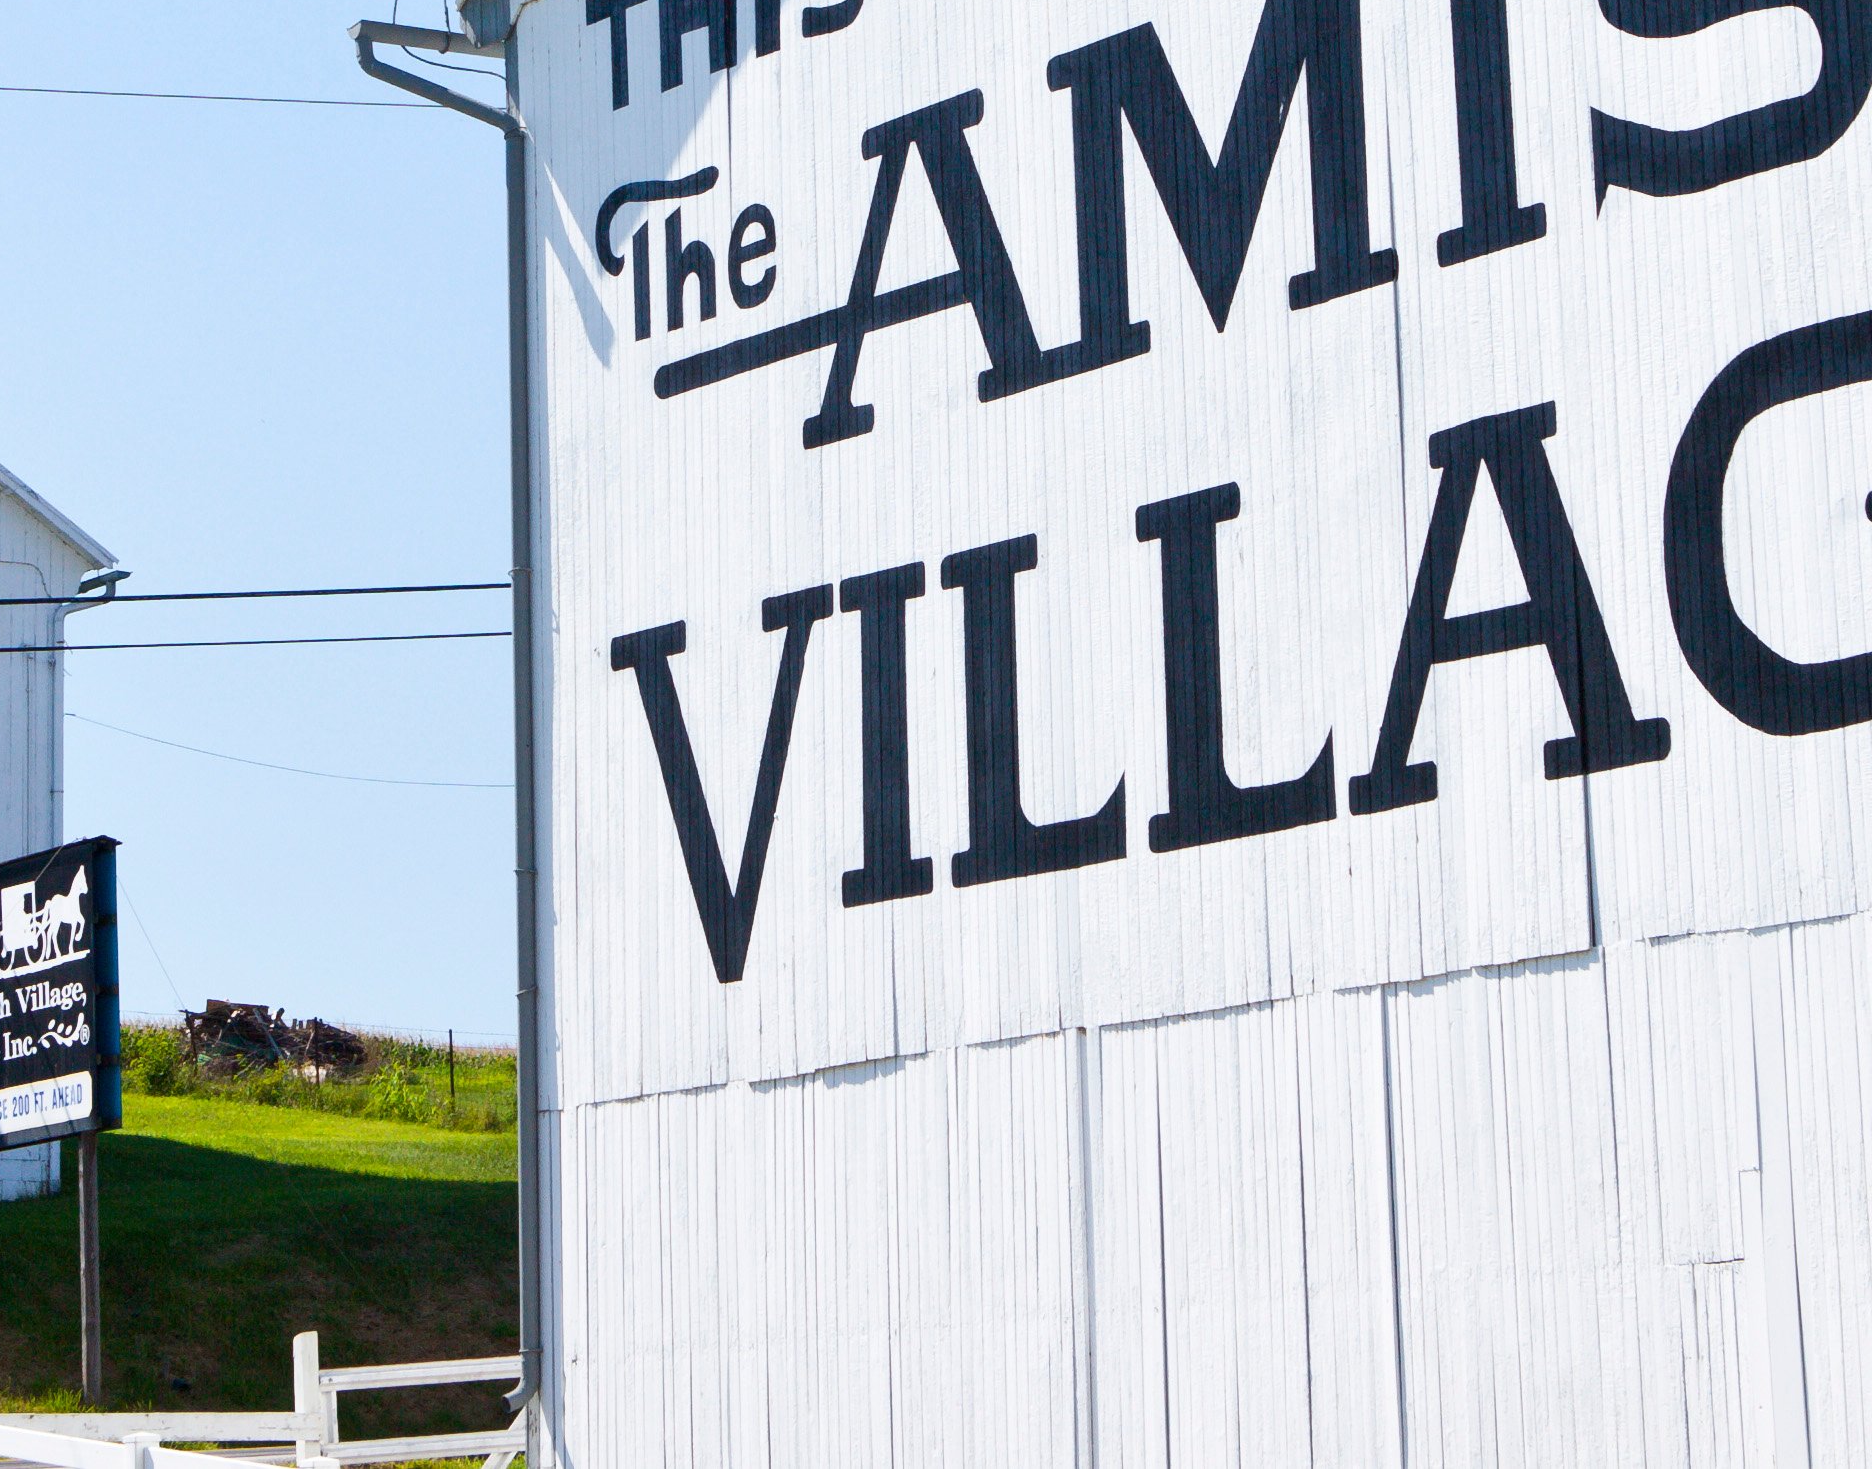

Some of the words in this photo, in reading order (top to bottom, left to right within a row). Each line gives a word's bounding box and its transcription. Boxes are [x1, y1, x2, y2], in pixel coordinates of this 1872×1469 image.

[596, 167, 776, 340] The
[16, 980, 86, 1014] Village,
[3, 1032, 37, 1061] Inc.
[12, 1095, 30, 1118] 200
[52, 1082, 82, 1110] AHEAD
